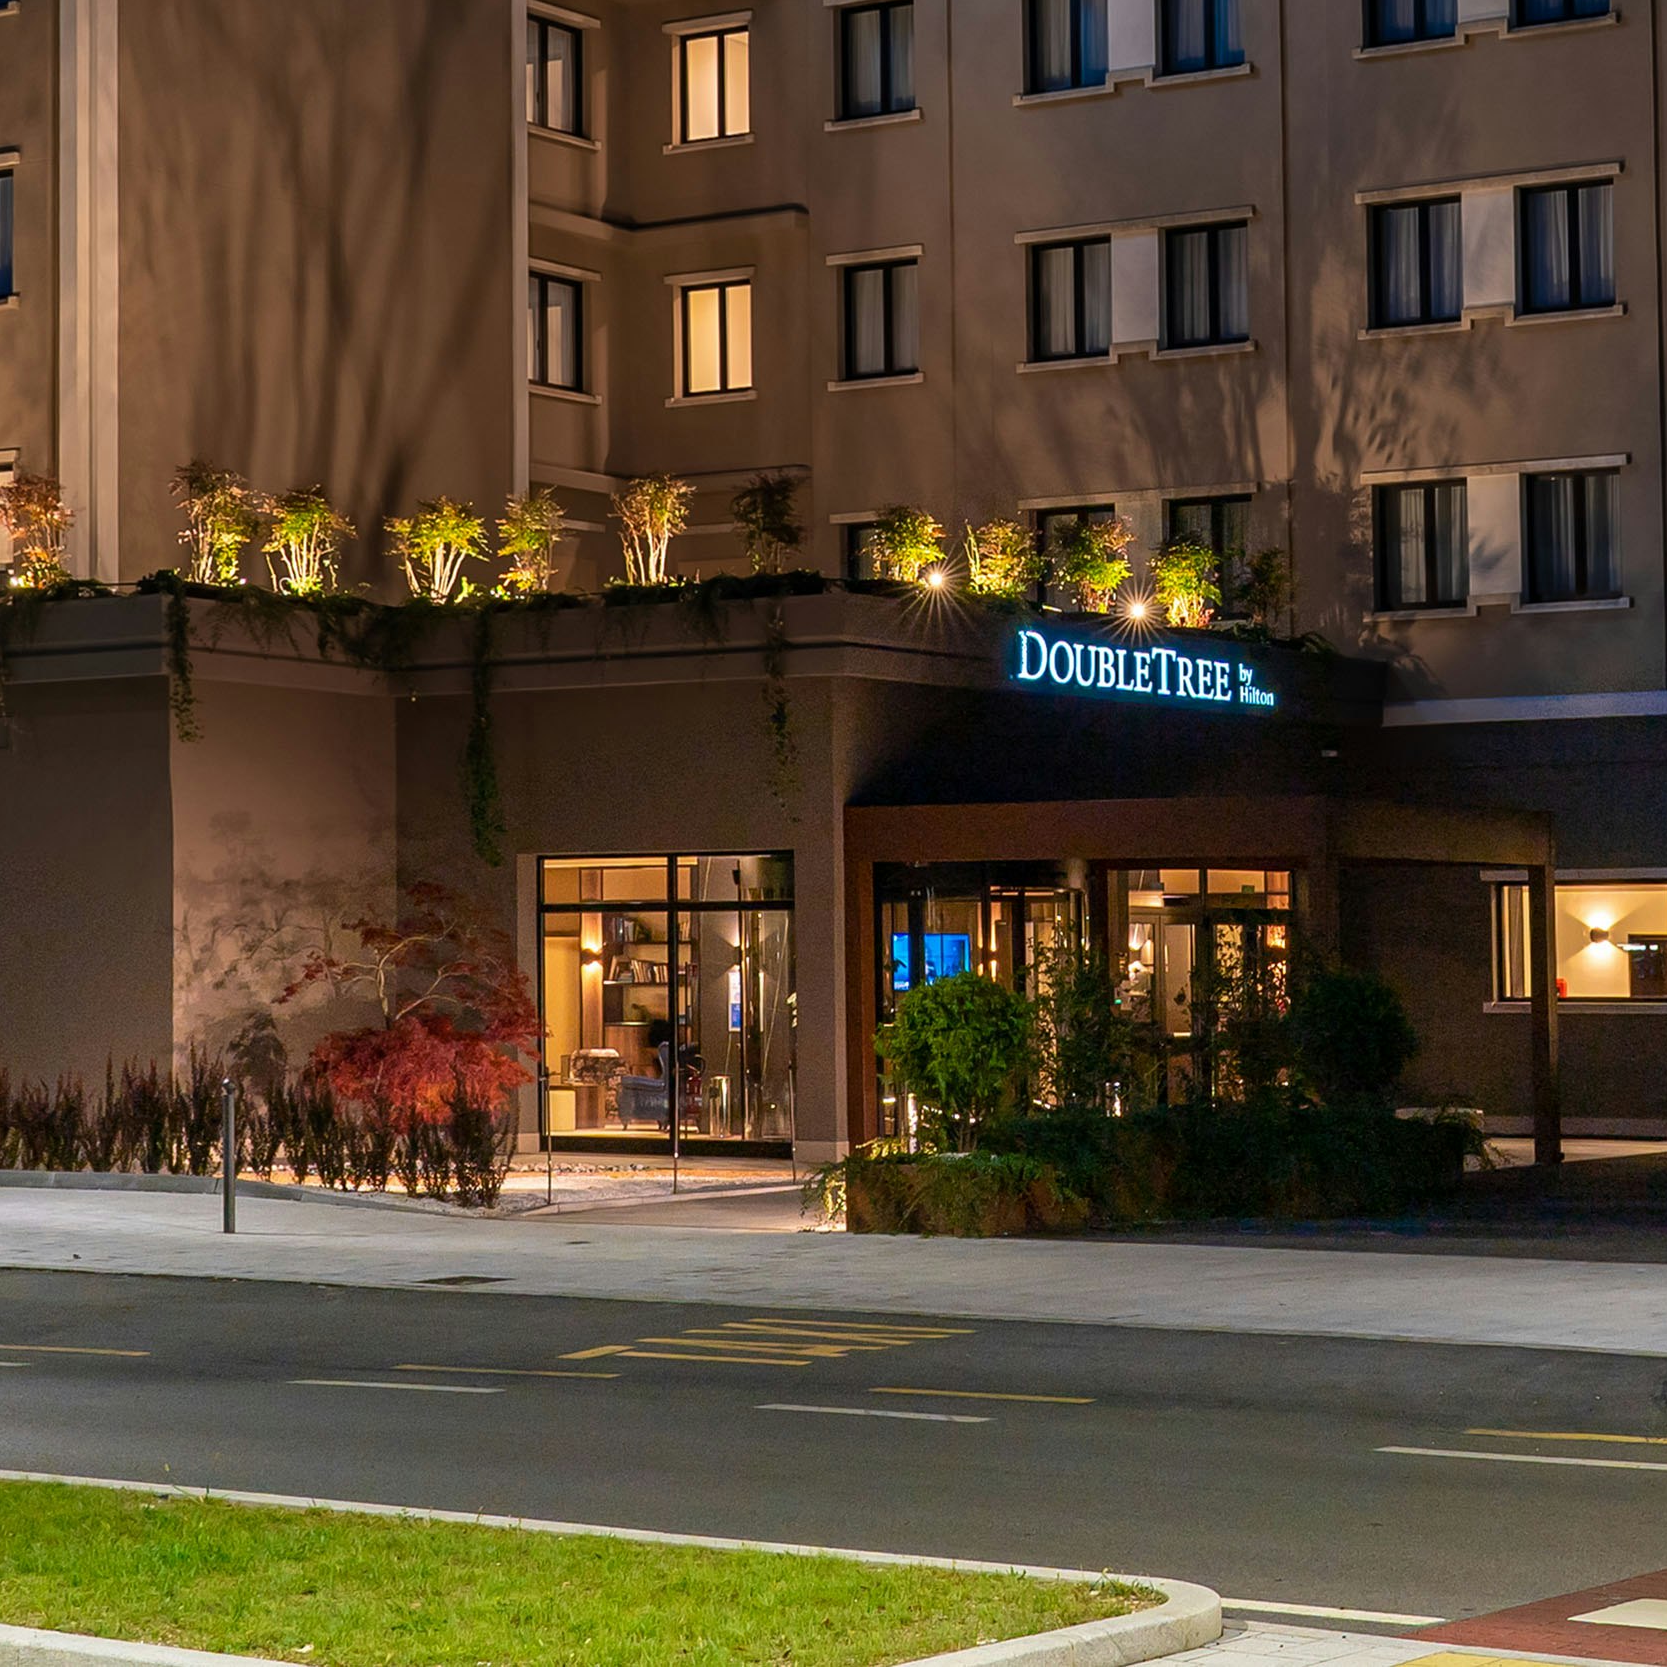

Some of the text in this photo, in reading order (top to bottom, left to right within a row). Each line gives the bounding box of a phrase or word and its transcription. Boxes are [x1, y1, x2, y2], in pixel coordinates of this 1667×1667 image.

[1238, 663, 1253, 686] by
[1239, 686, 1275, 707] Hilton
[555, 1318, 977, 1366] TAXI
